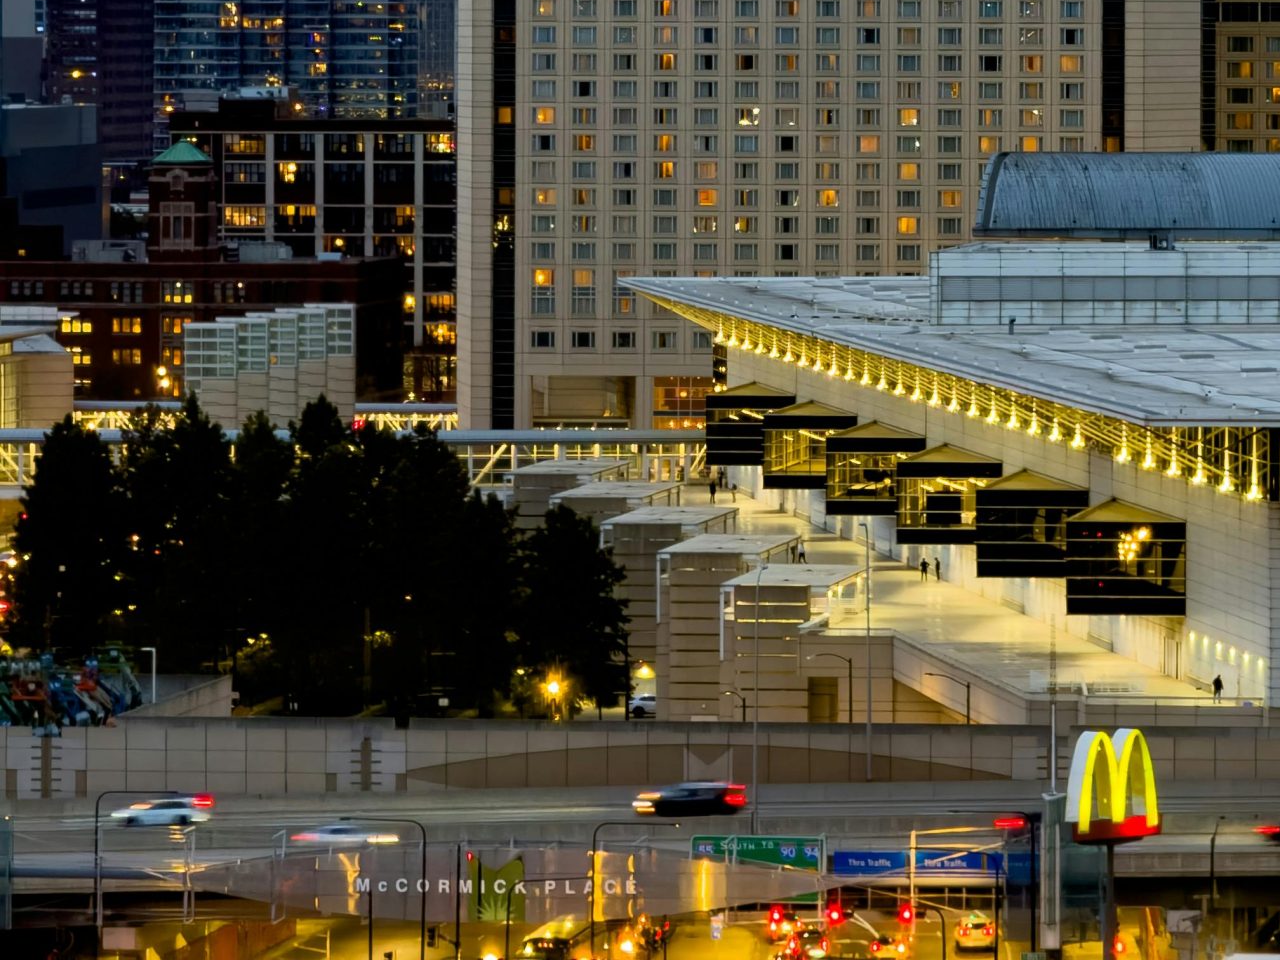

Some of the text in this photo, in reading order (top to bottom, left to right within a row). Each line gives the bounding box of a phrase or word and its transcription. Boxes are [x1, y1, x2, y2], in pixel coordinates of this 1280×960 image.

[719, 840, 755, 851] SOUTH
[780, 847, 796, 858] 90
[804, 846, 819, 858] 94
[847, 858, 892, 868] Thru Traffic
[544, 878, 639, 896] PLACE
